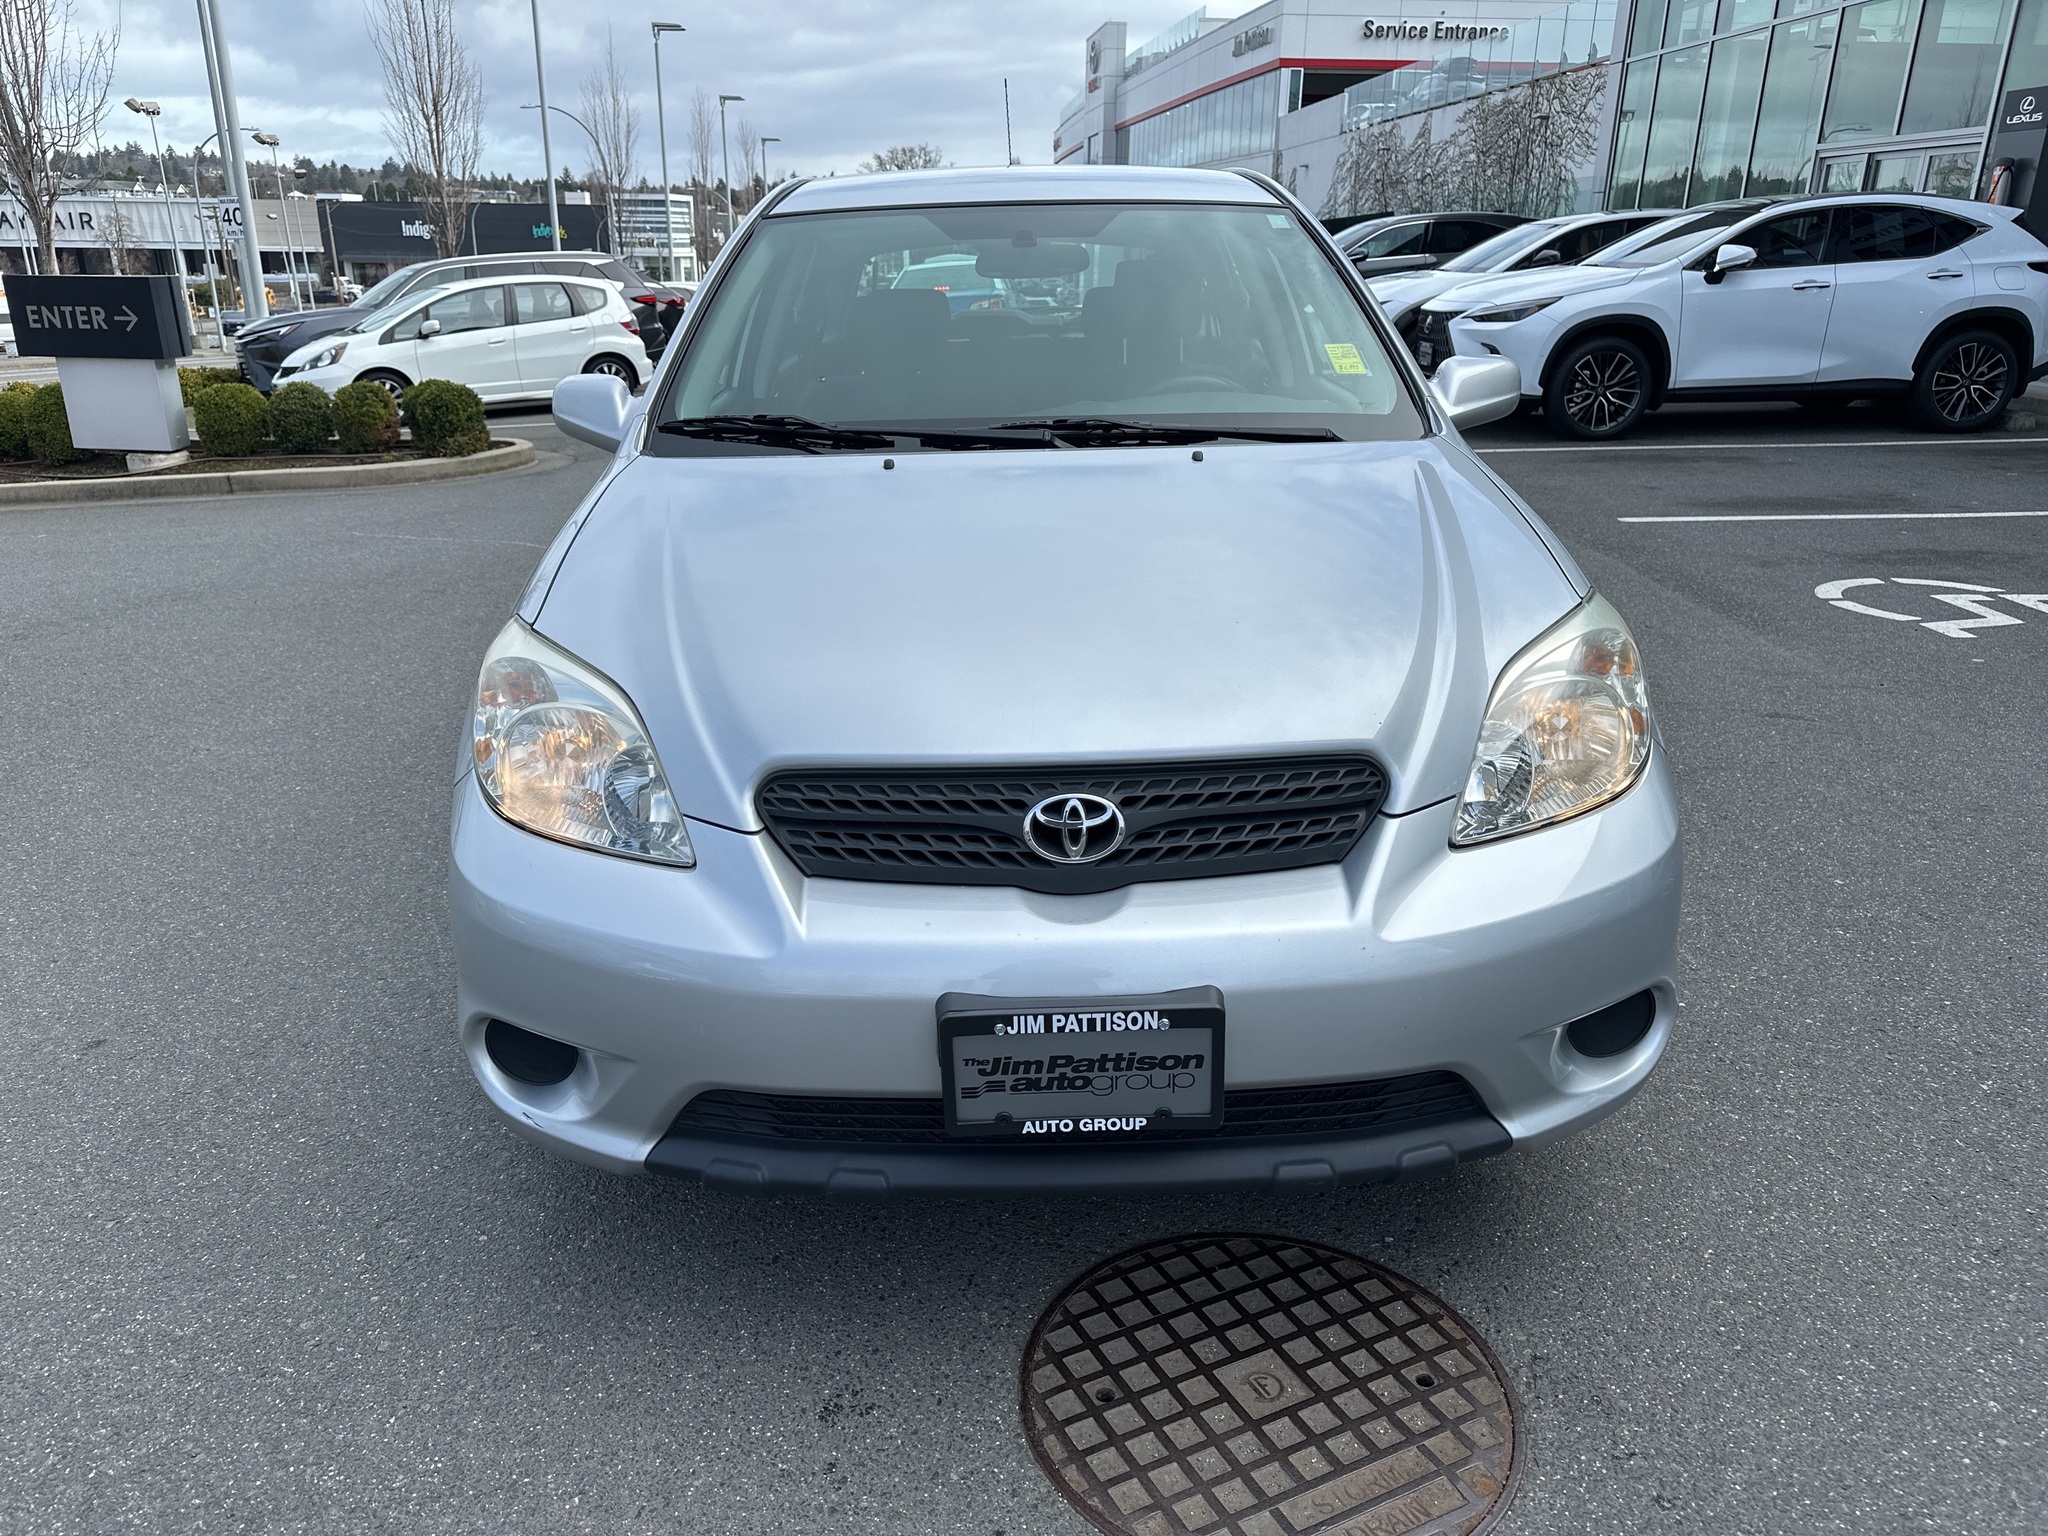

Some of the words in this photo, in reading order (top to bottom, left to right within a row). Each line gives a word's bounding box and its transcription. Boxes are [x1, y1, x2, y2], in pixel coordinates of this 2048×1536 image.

[1363, 19, 1428, 39] Service
[1434, 21, 1509, 40] Entrance
[2006, 112, 2043, 124] LEXUS
[222, 207, 243, 226] 40
[25, 305, 108, 330] ENTER
[1006, 1015, 1045, 1034] JIM
[1052, 1011, 1158, 1033] PATTISON
[962, 1057, 990, 1067] The
[977, 1055, 1045, 1077] Jim
[1046, 1052, 1205, 1075] Pattison
[1022, 1120, 1074, 1134] AUTO
[1079, 1117, 1147, 1132] GROUP
